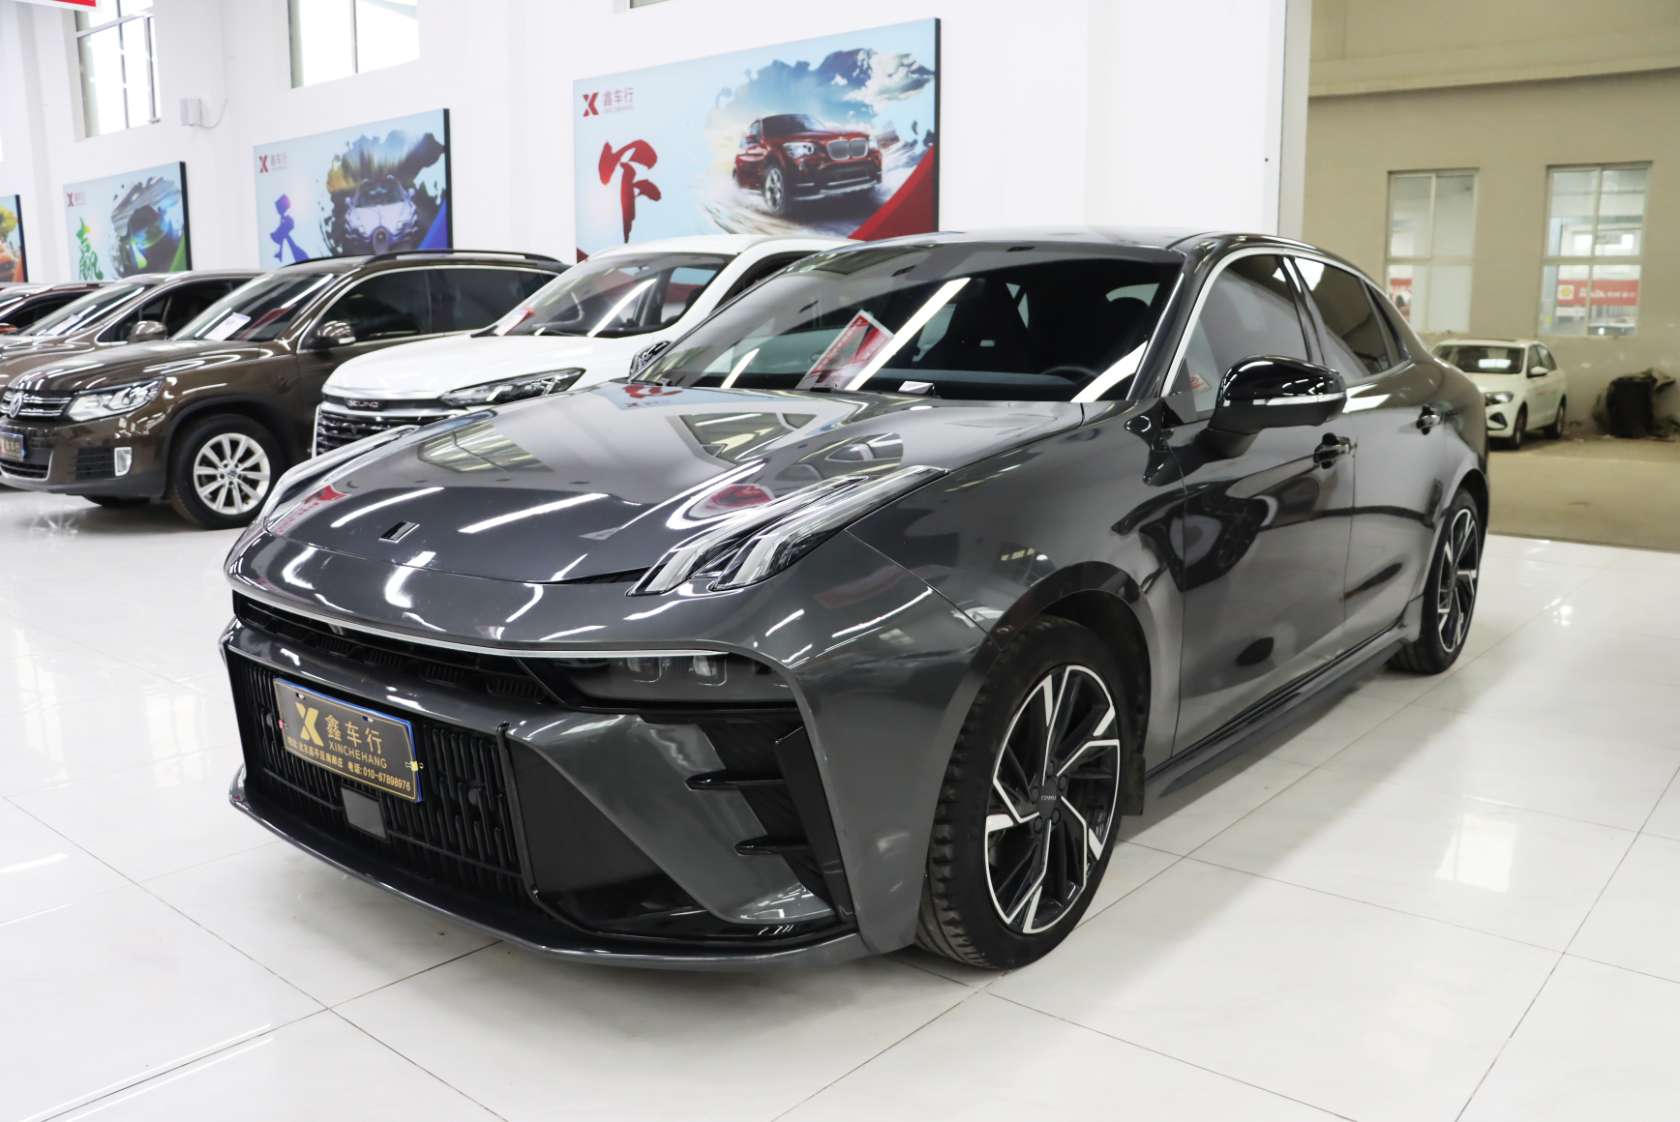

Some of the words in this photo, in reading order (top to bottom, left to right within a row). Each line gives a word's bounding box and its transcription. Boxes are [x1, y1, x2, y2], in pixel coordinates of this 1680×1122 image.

[324, 714, 383, 754] 鑫车行
[329, 740, 388, 769] XINCHEHANG
